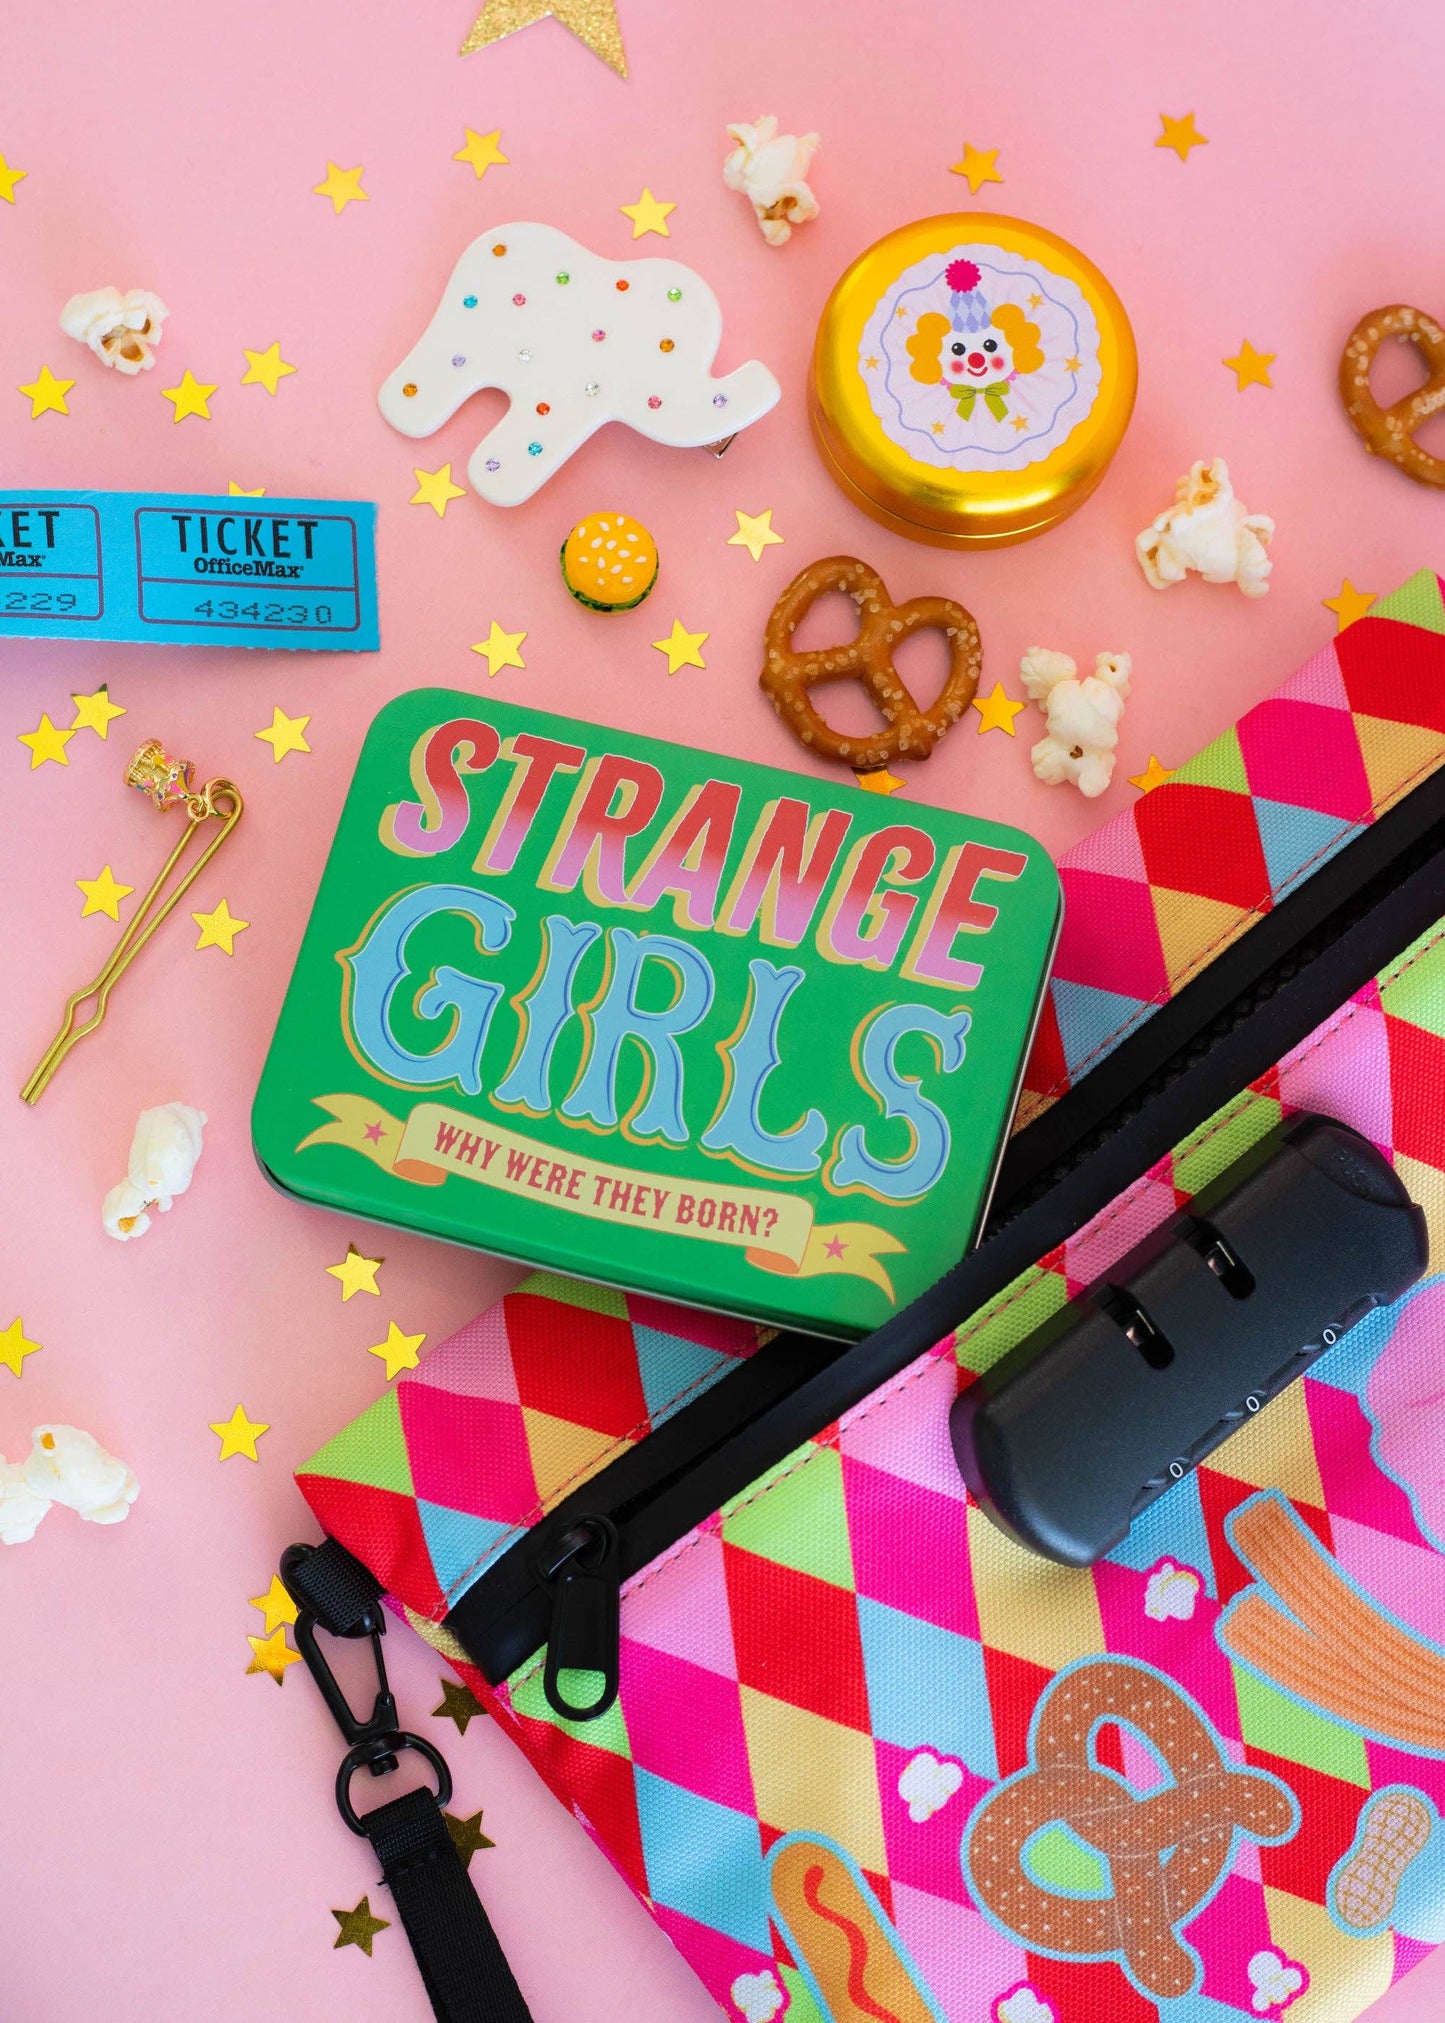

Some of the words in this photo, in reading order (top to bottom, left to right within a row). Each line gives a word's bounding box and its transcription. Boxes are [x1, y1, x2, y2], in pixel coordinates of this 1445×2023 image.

[0, 511, 59, 548] ET
[171, 515, 318, 560] TICKET
[193, 557, 301, 578] OfficeMax
[194, 600, 332, 624] 434230
[378, 718, 1028, 990] STRANGE
[338, 883, 973, 1205] GIRLS
[434, 1121, 502, 1170] WHY
[505, 1148, 583, 1200] WERE
[592, 1175, 671, 1221] THEY
[675, 1194, 779, 1238] BORN?
[1169, 1462, 1183, 1478] 0
[1246, 1396, 1259, 1412] 0
[1323, 1329, 1336, 1345] 0
